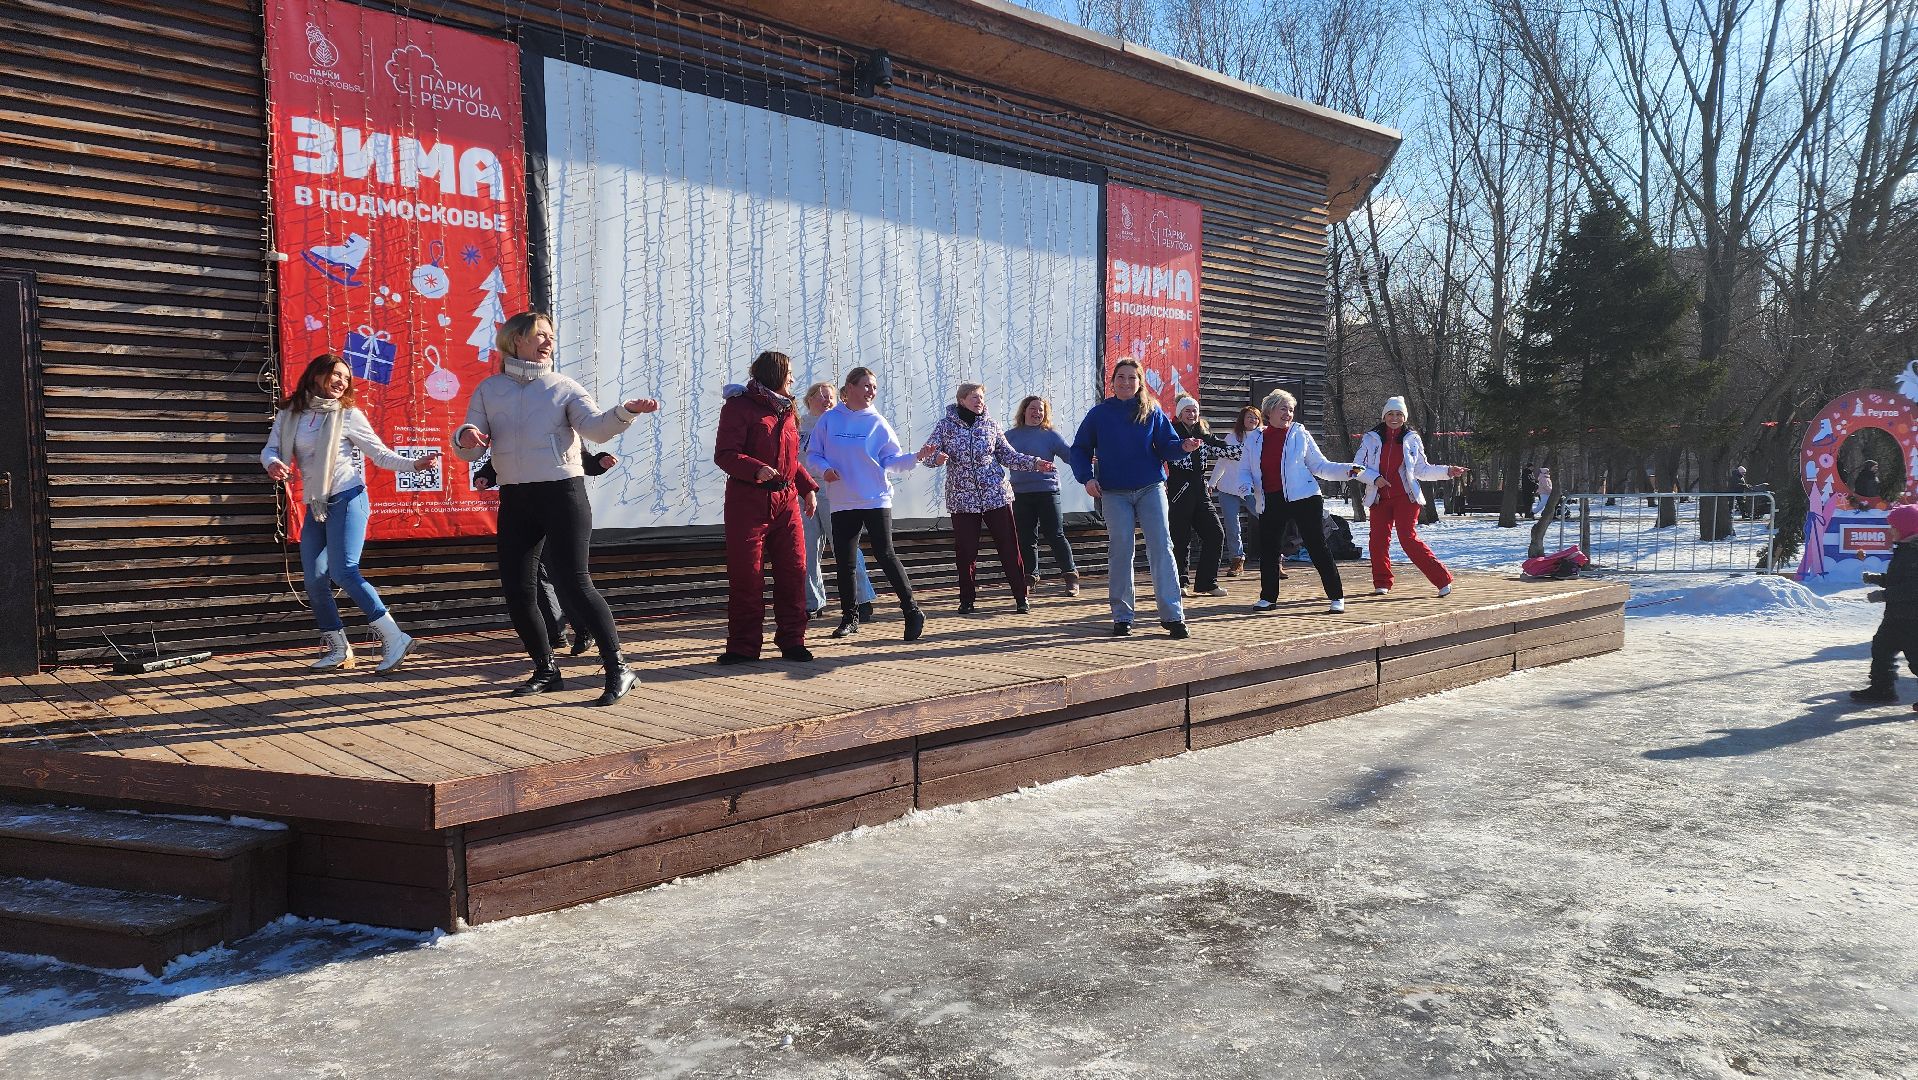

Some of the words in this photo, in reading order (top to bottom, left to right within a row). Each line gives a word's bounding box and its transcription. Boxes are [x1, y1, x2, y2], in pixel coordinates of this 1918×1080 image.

[309, 68, 340, 80] ПАРКИ
[420, 75, 482, 100] ПАРКИ
[420, 92, 502, 120] РЕУТОВА
[291, 116, 505, 201] ЗИМА
[294, 186, 314, 206] В
[319, 187, 508, 233] ПОДМОСКОВЬЕ
[1162, 227, 1186, 241] ПАРКИ
[1114, 259, 1193, 302] ЗИМА
[1113, 301, 1121, 313] В
[1122, 302, 1193, 321] ПОДМОСКОВЬЕ
[1868, 408, 1899, 418] Реутов
[1850, 531, 1886, 542] ЗИМА
